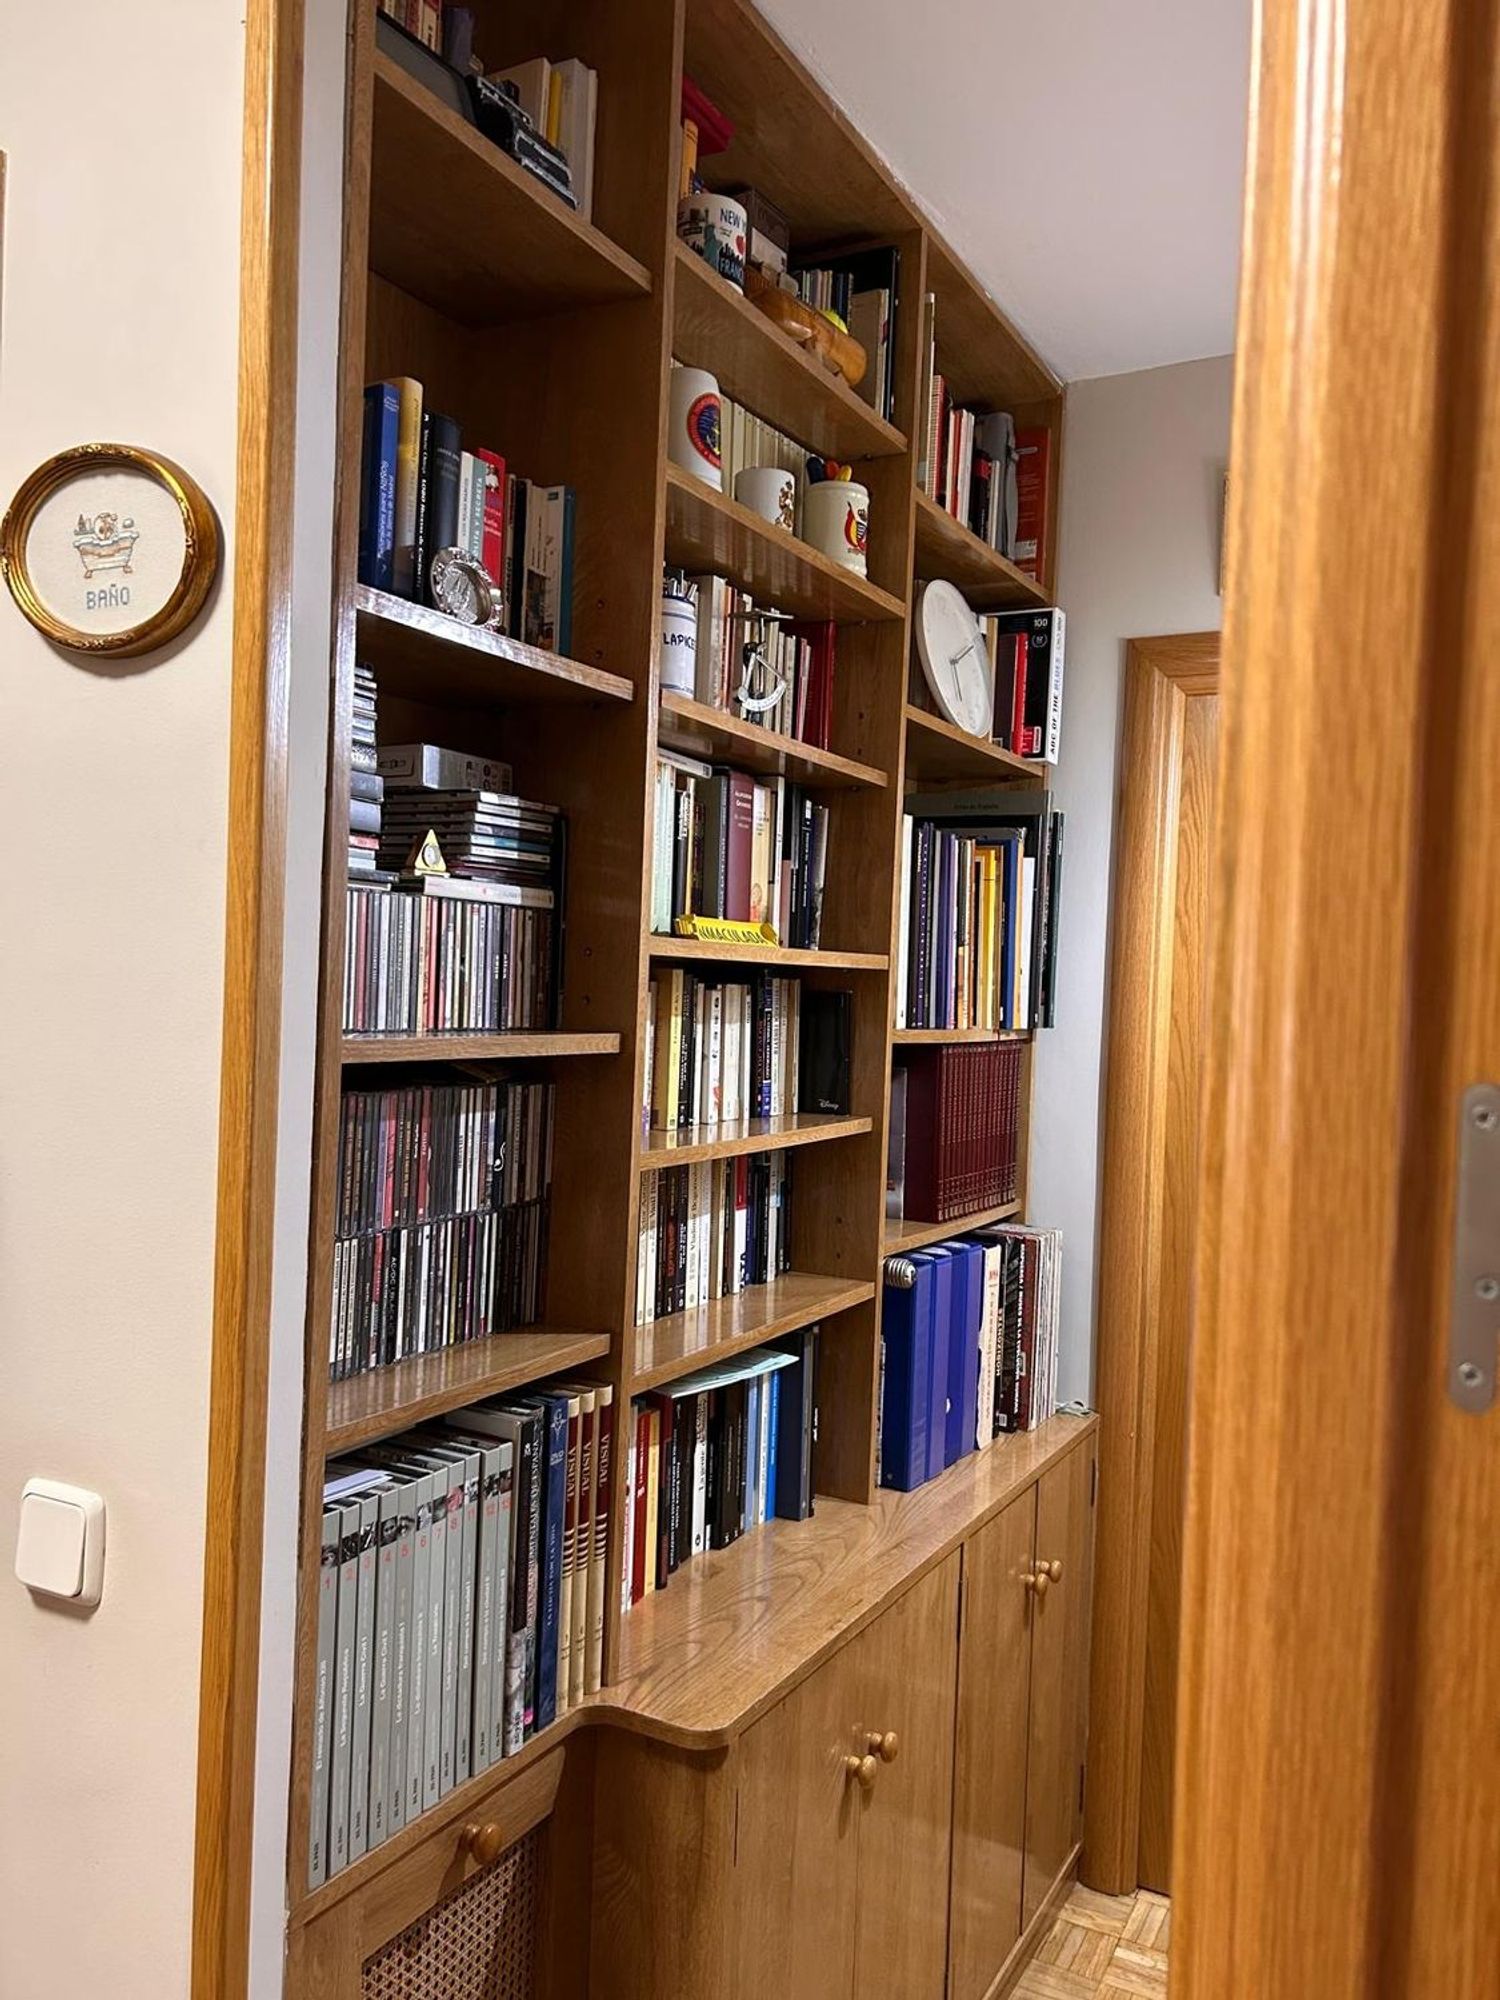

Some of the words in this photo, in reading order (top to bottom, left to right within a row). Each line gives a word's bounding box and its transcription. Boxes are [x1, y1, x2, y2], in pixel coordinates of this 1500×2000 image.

[86, 584, 130, 609] BAÑO
[663, 632, 696, 651] LAPICE
[1052, 718, 1057, 730] OF
[818, 1098, 840, 1111] Disney
[1017, 1318, 1022, 1327] DE
[1016, 1329, 1022, 1339] LA
[582, 1441, 592, 1496] VISUAL
[599, 1434, 610, 1488] VISUAL
[567, 1446, 576, 1501] VISUAL
[420, 1535, 427, 1548] 6
[360, 1642, 368, 1662] Civil
[380, 1637, 388, 1656] Civil
[431, 1644, 439, 1656] La
[340, 1648, 351, 1693] República
[358, 1664, 368, 1691] Guerra
[379, 1658, 388, 1686] Guerra
[318, 1676, 328, 1709] Alfonso
[379, 1688, 387, 1700] La
[396, 1668, 405, 1710] dictadura
[358, 1694, 366, 1706] La
[414, 1702, 422, 1714] La
[318, 1712, 326, 1723] de
[340, 1694, 350, 1732] Segunda
[395, 1711, 404, 1724] La
[340, 1735, 347, 1748] La
[315, 1760, 323, 1770] El
